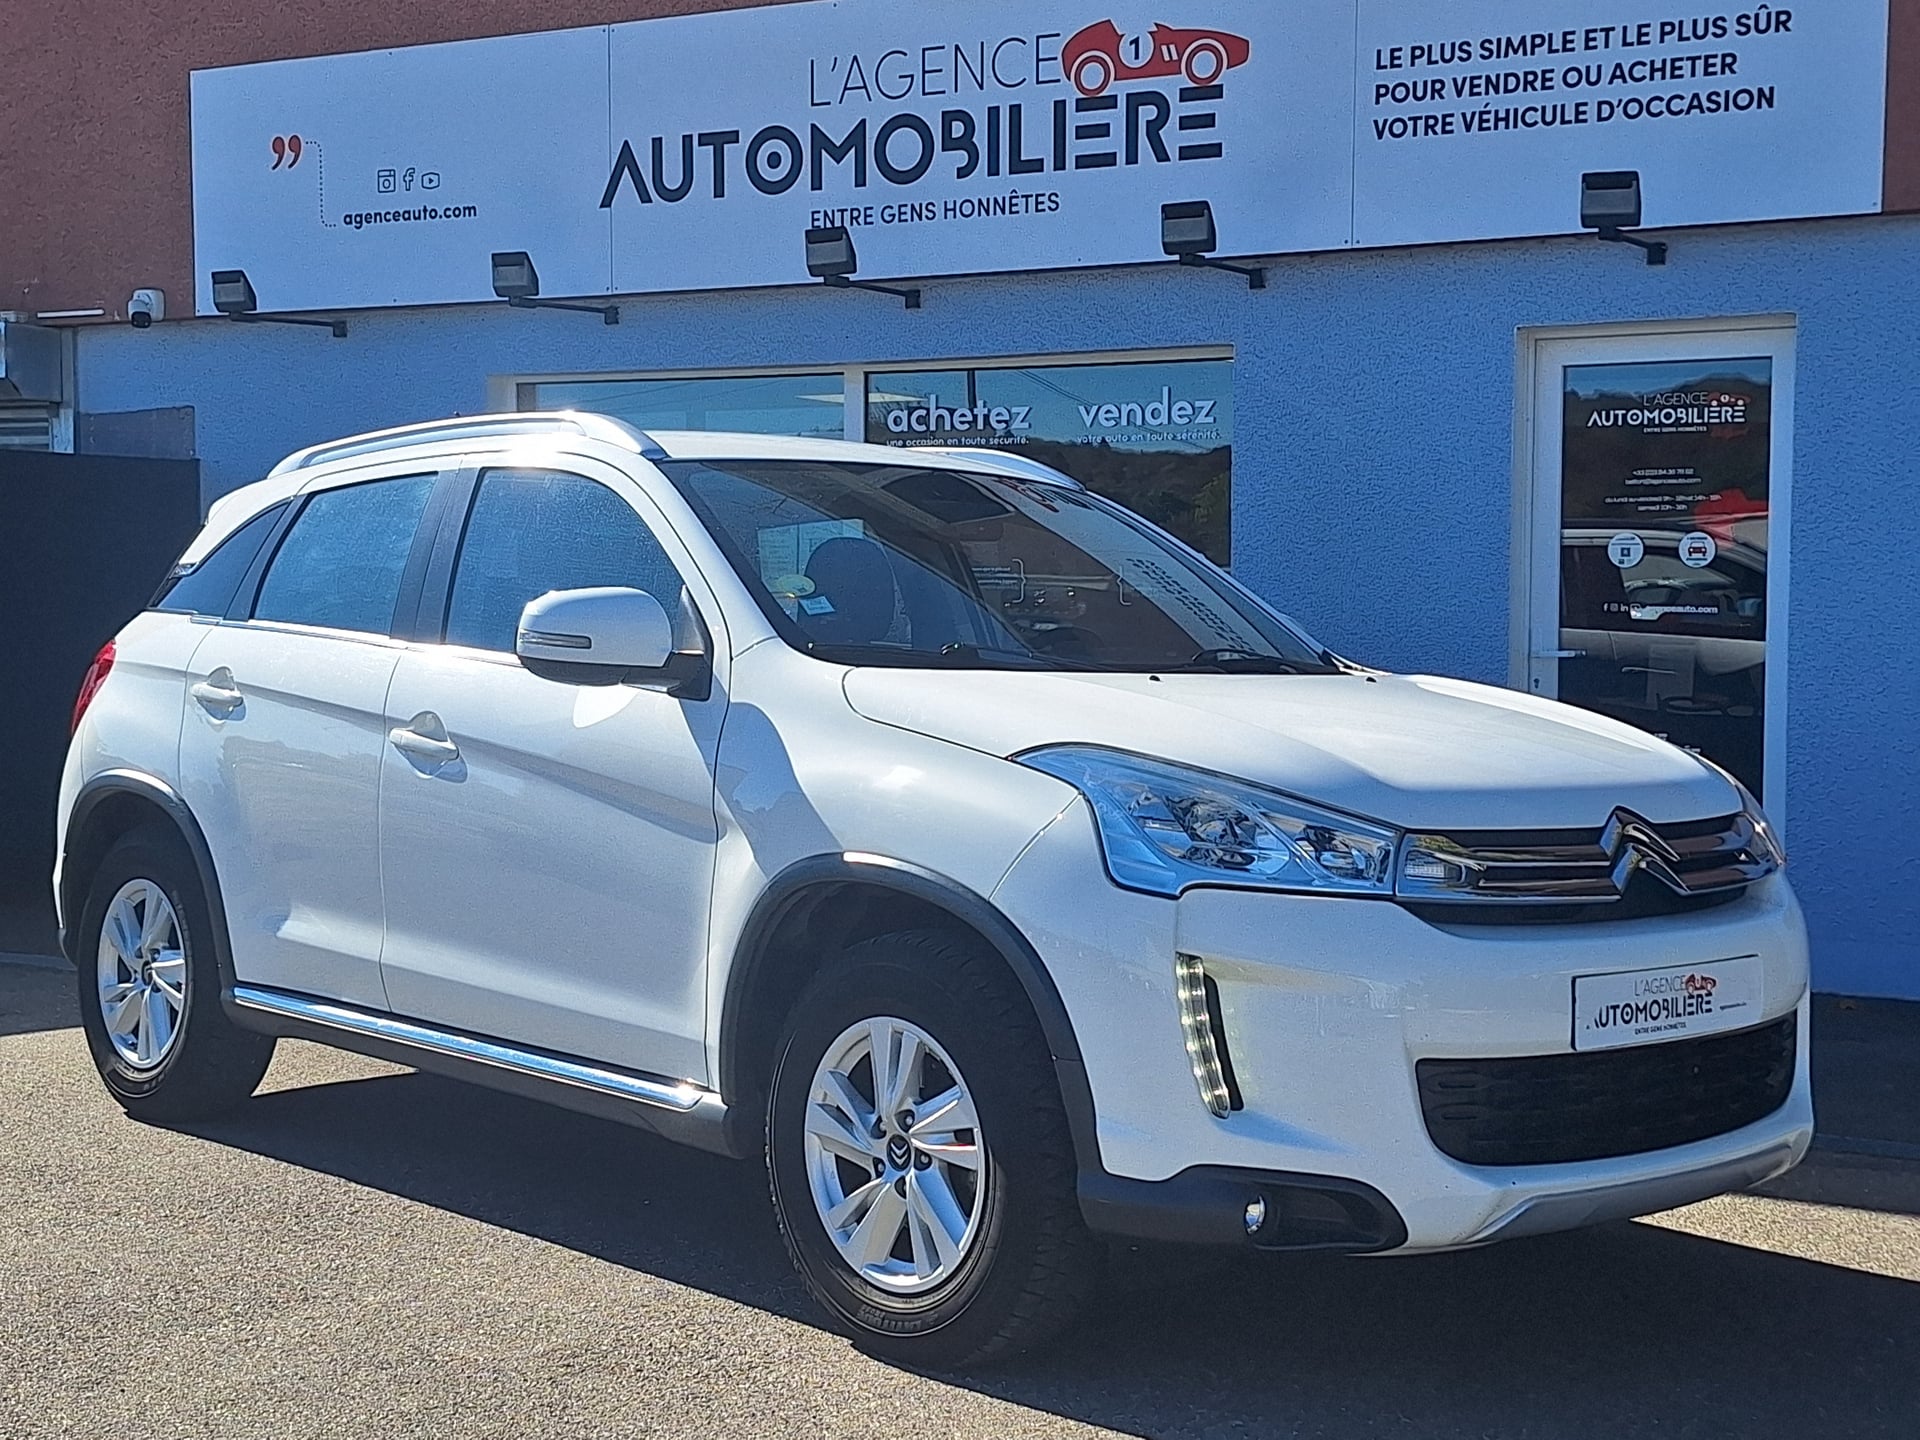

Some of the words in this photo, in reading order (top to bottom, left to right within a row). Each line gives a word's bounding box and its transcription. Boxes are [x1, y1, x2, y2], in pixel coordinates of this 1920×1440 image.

[1376, 47, 1403, 70] LE
[1410, 41, 1473, 68] PLUS
[1479, 28, 1577, 60] SIMPLE
[1584, 27, 1616, 50] ET
[1622, 23, 1652, 47] LE
[1659, 16, 1728, 43] PLUS
[1735, 4, 1792, 36] SÛR
[811, 33, 1062, 107] L'AGENCE
[1375, 79, 1446, 105] POUR
[1452, 69, 1555, 98] VENDRE
[1562, 64, 1603, 88] OU
[1608, 53, 1738, 85] ACHETER
[1373, 113, 1455, 140] VOTRE
[1461, 102, 1589, 132] VÉHICULE
[1597, 86, 1775, 122] D'OCCASION
[344, 205, 477, 229] agenceauto.com
[811, 207, 874, 229] ENTRE
[881, 202, 937, 224] GENS
[944, 189, 1060, 220] HONNÊTES
[887, 394, 1032, 433] achetez
[1078, 386, 1216, 428] vendez
[1643, 392, 1708, 406] L'AGENCE
[906, 436, 944, 446] occasion
[961, 436, 986, 446] toute
[1147, 432, 1174, 441] toute
[1634, 975, 1686, 997] L'AGENCE
